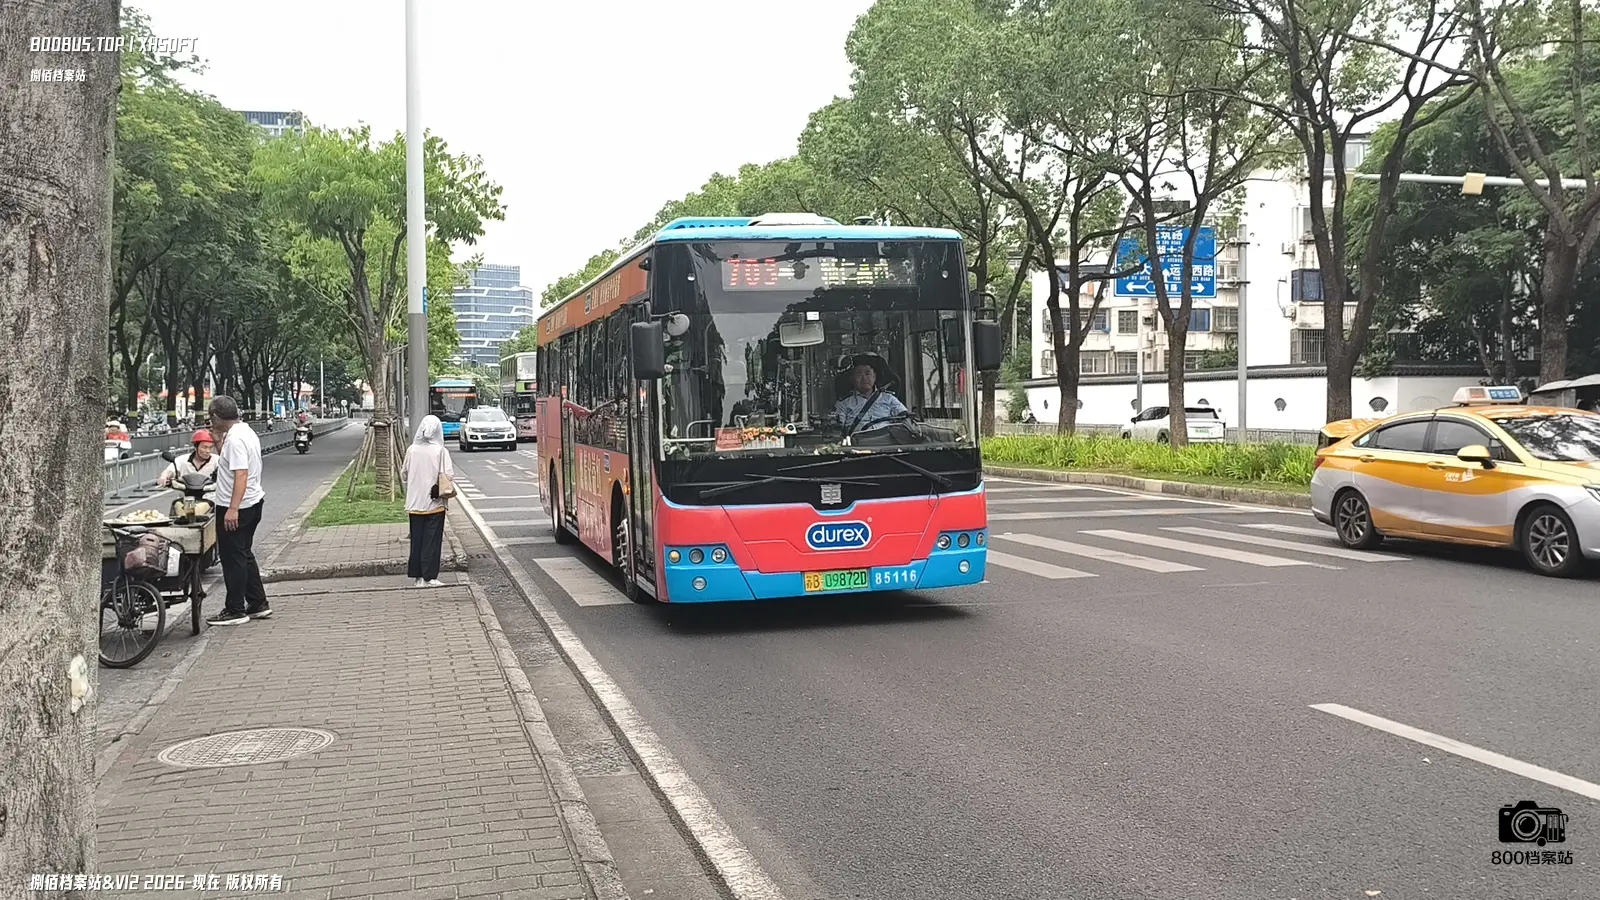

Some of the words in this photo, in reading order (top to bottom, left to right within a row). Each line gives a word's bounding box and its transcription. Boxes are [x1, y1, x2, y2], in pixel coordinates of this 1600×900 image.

[727, 259, 778, 286] 703
[812, 525, 866, 545] durex
[825, 571, 867, 588] 09872D
[875, 569, 917, 585] 85116
